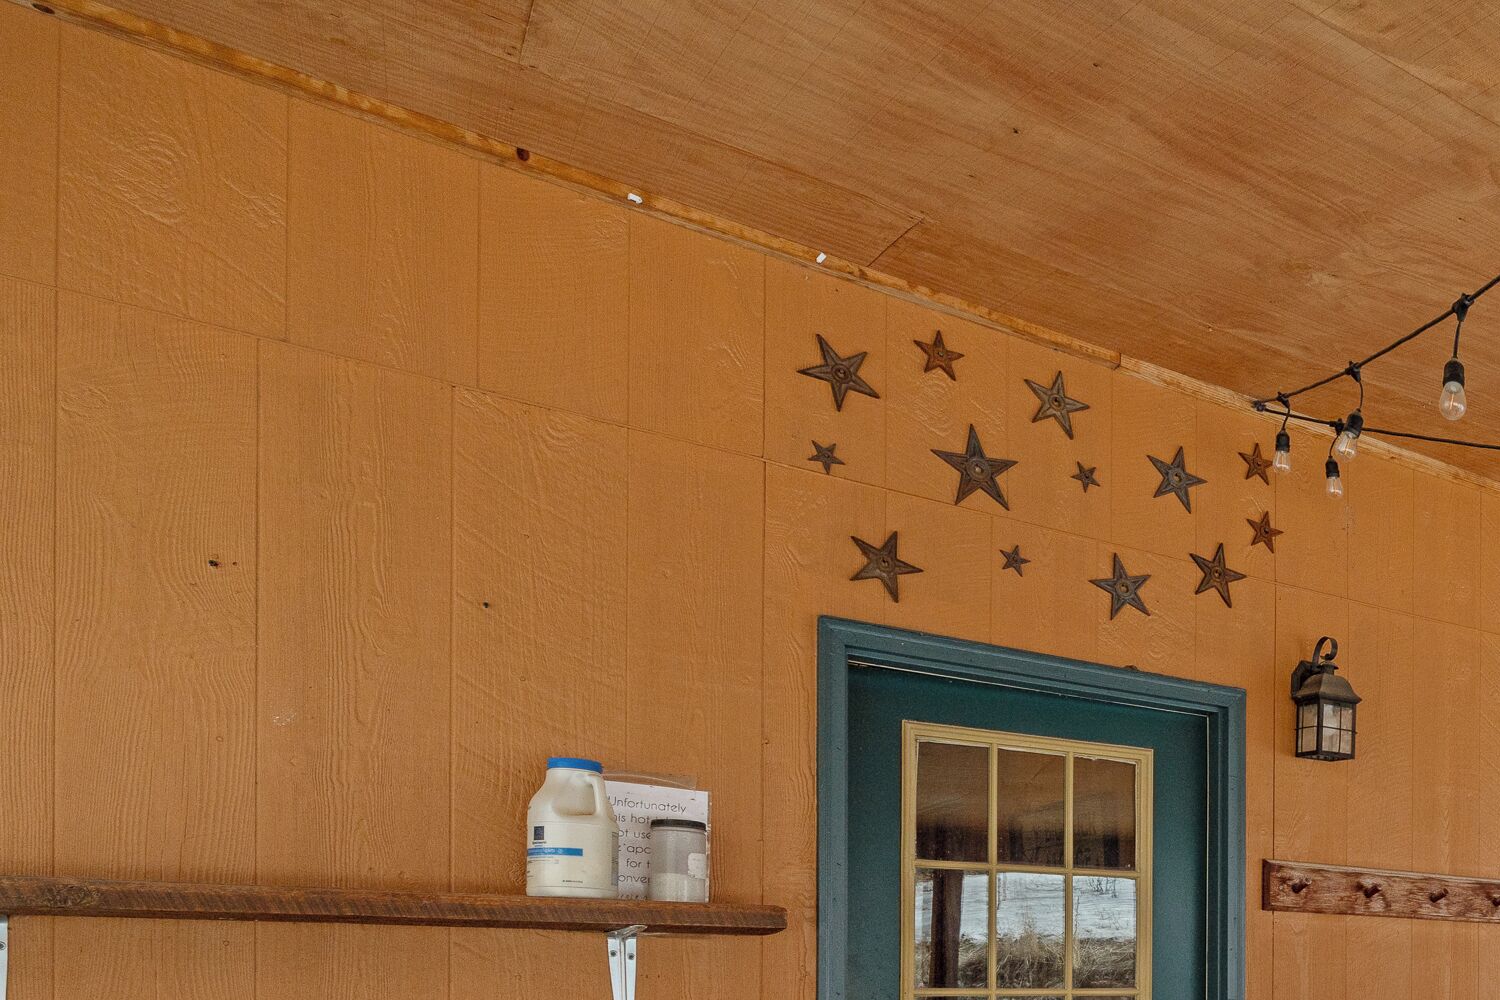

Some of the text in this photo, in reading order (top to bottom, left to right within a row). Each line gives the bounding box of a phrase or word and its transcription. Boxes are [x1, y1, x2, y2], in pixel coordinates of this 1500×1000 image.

[608, 796, 686, 814] Unfortunately
[631, 813, 650, 825] hot
[627, 857, 642, 868] for
